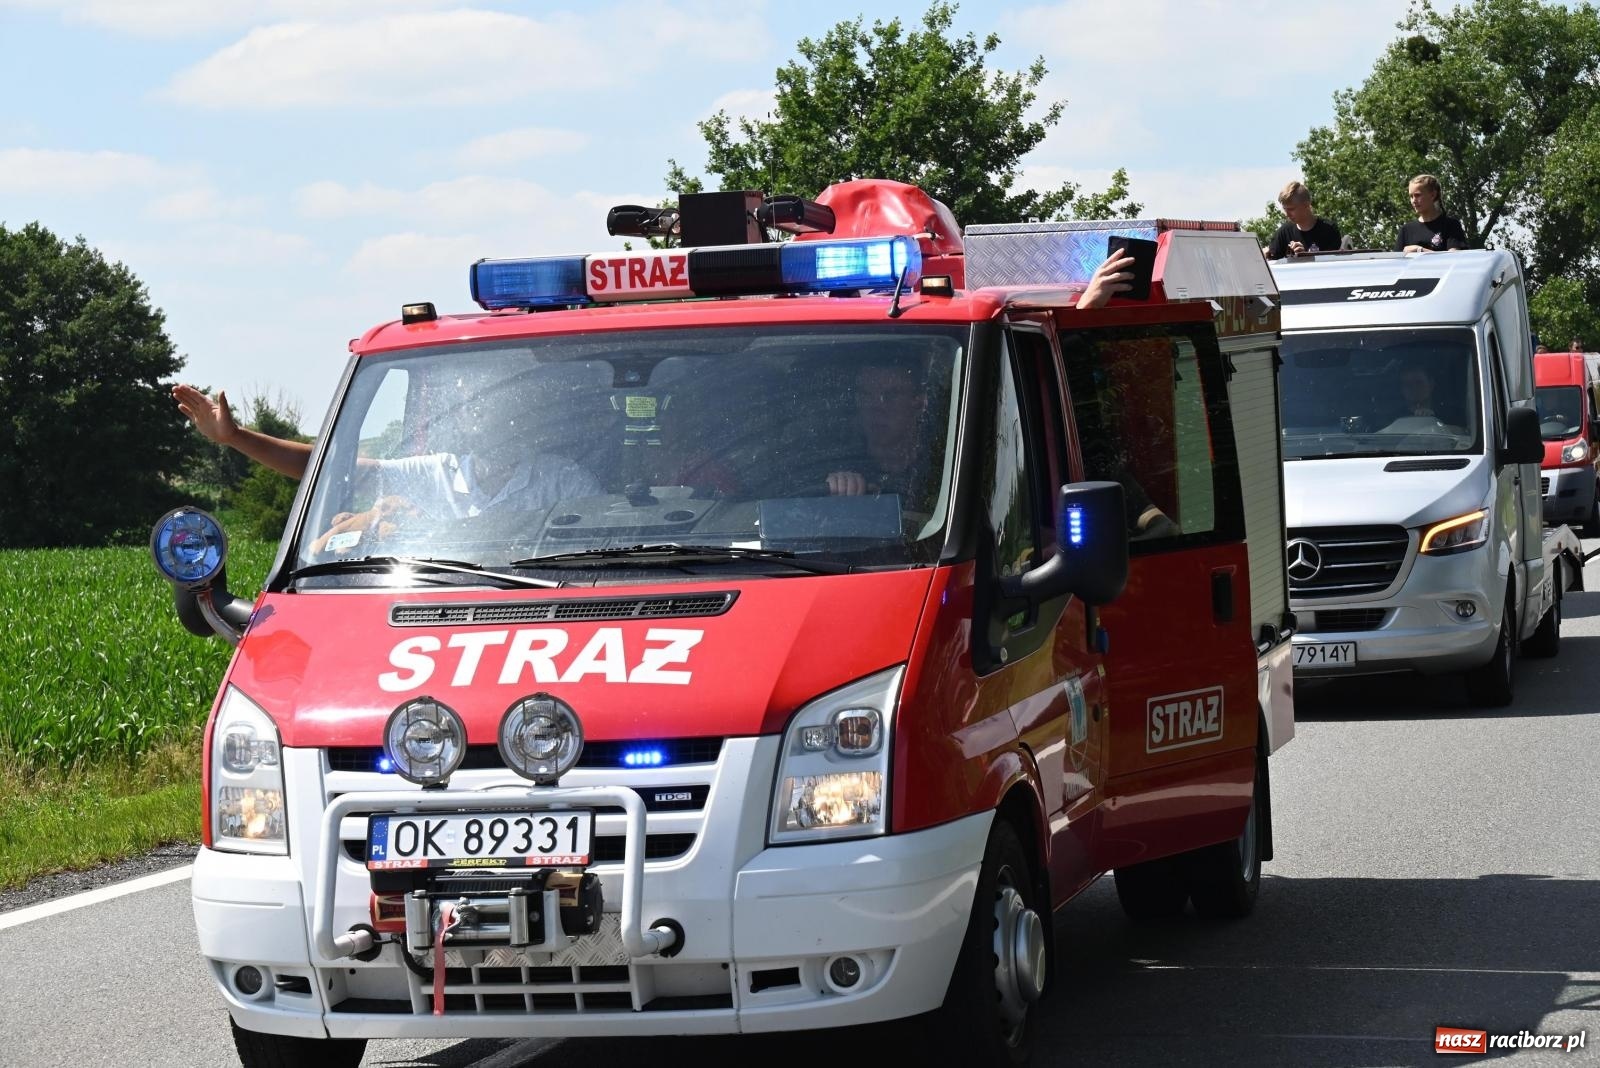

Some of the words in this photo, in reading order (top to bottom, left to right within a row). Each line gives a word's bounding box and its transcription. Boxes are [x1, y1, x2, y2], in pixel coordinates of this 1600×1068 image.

[1296, 645, 1349, 663] 7914Y
[394, 819, 448, 857] OK
[463, 816, 579, 856] 89331
[372, 845, 385, 856] PL
